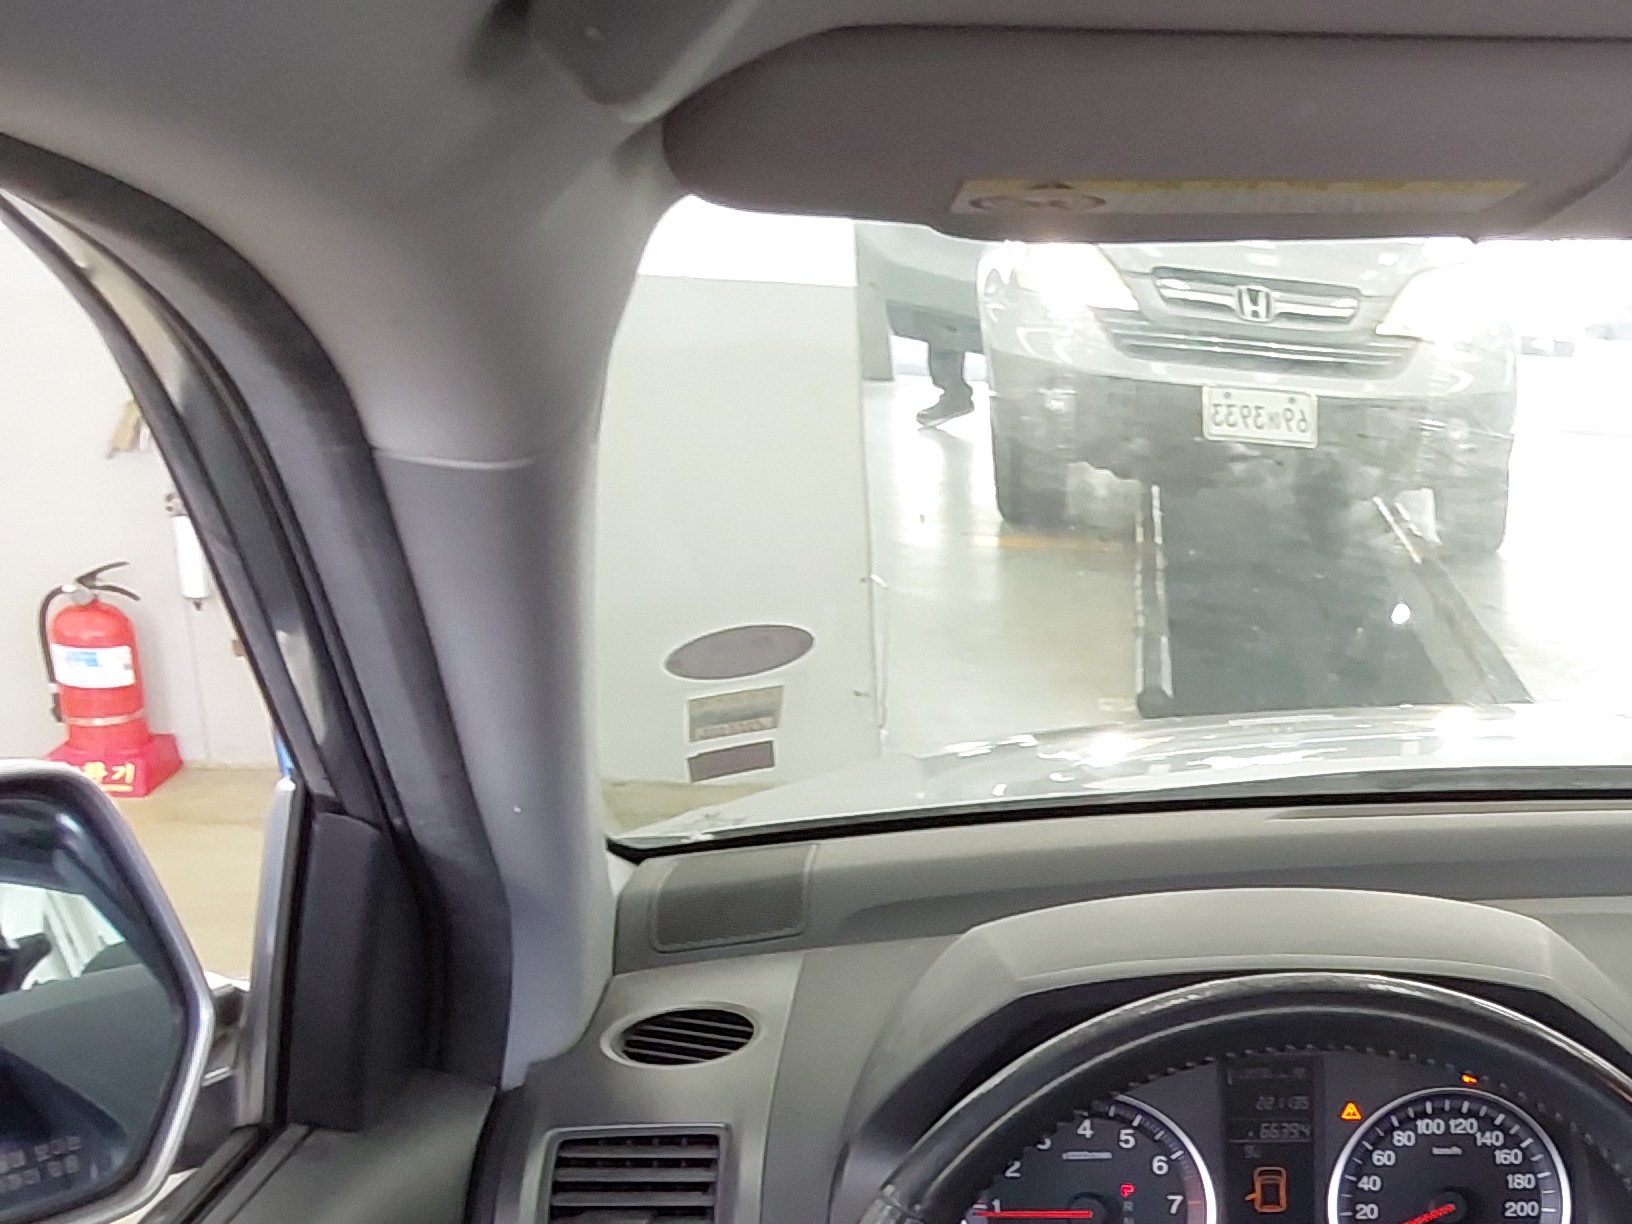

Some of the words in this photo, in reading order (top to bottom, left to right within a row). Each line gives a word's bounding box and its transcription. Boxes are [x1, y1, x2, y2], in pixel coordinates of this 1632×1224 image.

[82, 761, 136, 784] 화기
[1076, 1119, 1094, 1138] 4
[1416, 1118, 1446, 1135] 100
[1449, 1118, 1479, 1135] 120
[1118, 1129, 1136, 1149] 5
[1392, 1131, 1416, 1147] 80
[1476, 1131, 1505, 1147] 140
[1152, 1155, 1169, 1175] 6
[1372, 1150, 1396, 1166] 60
[1494, 1149, 1523, 1165] 160
[1357, 1175, 1382, 1191] 40
[1506, 1173, 1536, 1190] 180
[1167, 1195, 1184, 1214] 7
[1355, 1204, 1379, 1220] 20
[1504, 1202, 1539, 1217] 200
